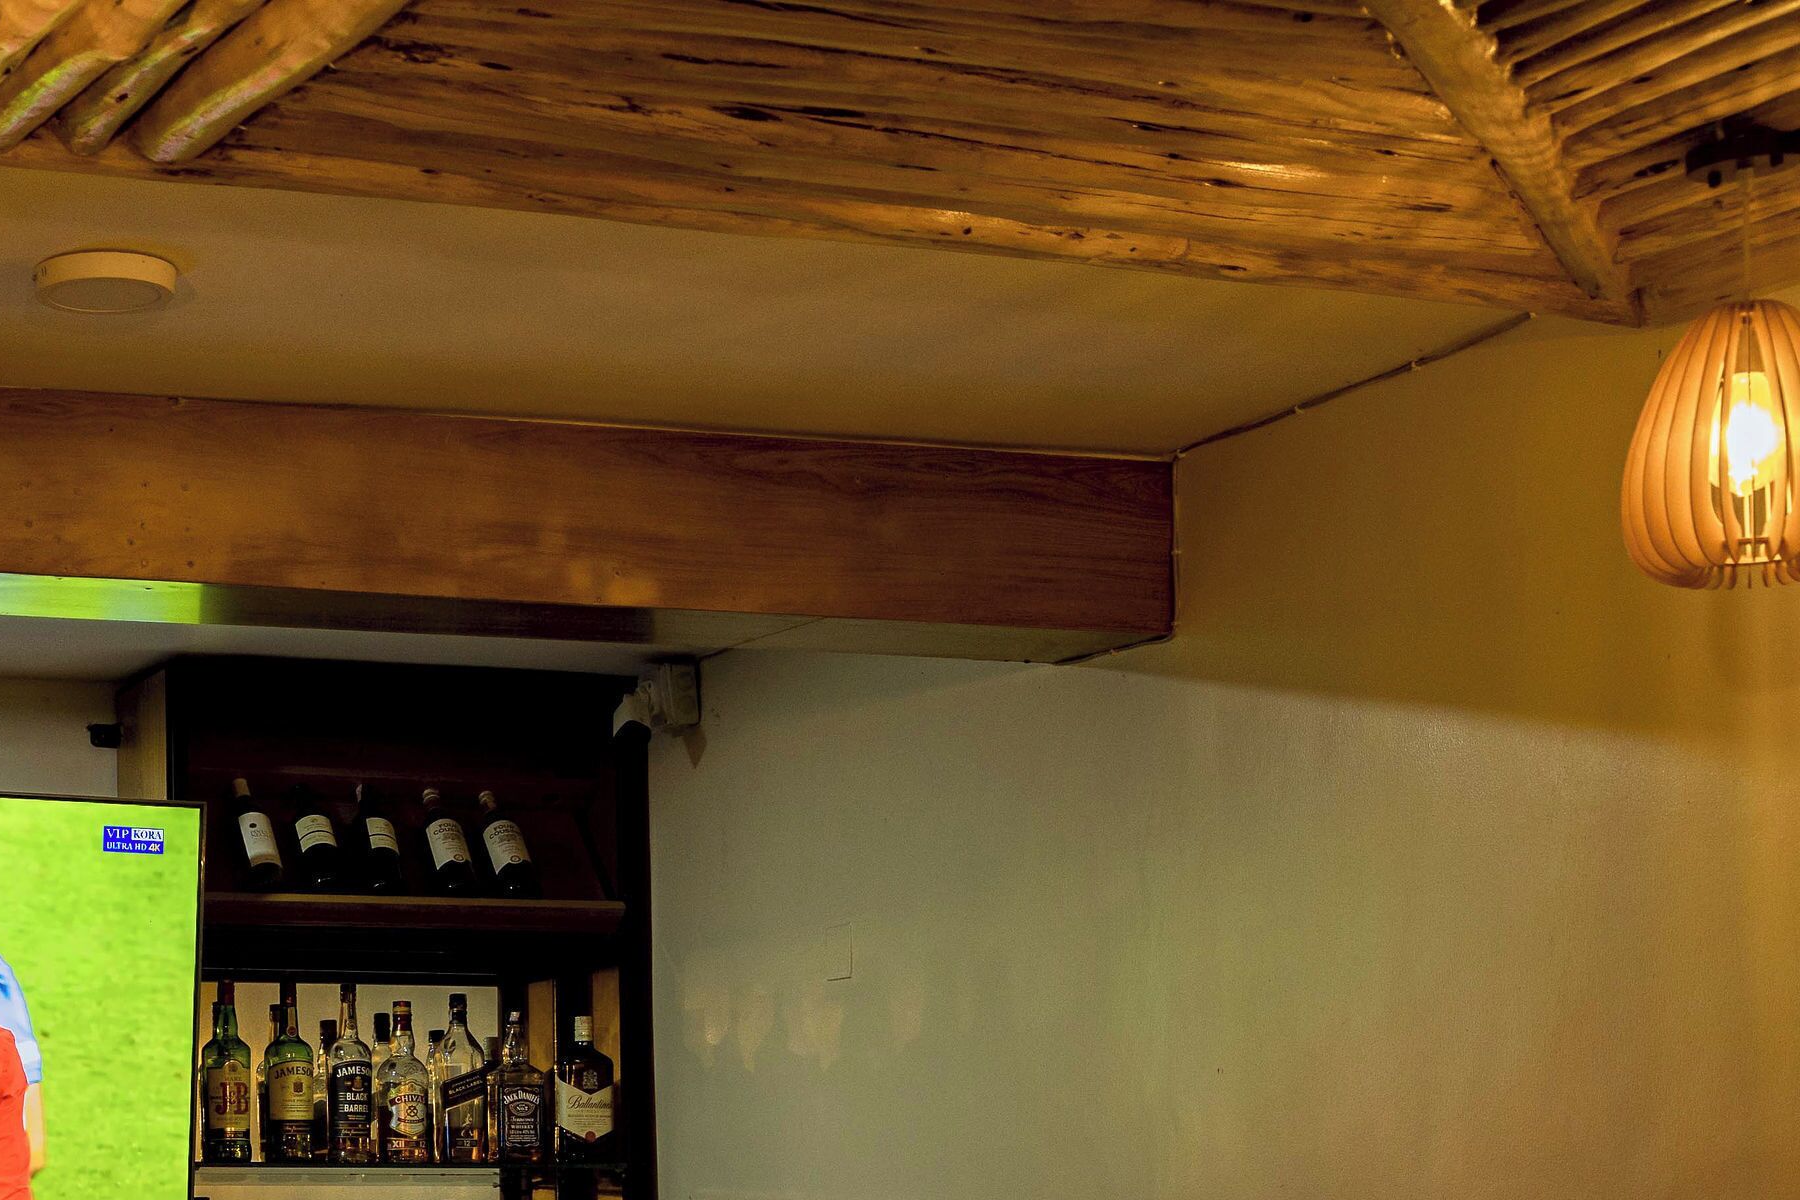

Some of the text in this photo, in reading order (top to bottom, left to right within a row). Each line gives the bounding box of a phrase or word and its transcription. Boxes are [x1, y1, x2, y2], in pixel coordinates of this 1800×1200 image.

[106, 828, 162, 840] VIP KORA
[106, 841, 161, 852] ULTRA HD 4K
[215, 1081, 249, 1115] J&B
[346, 1091, 368, 1101] BLACK
[503, 1092, 518, 1105] JACK
[343, 1104, 369, 1113] BARREL
